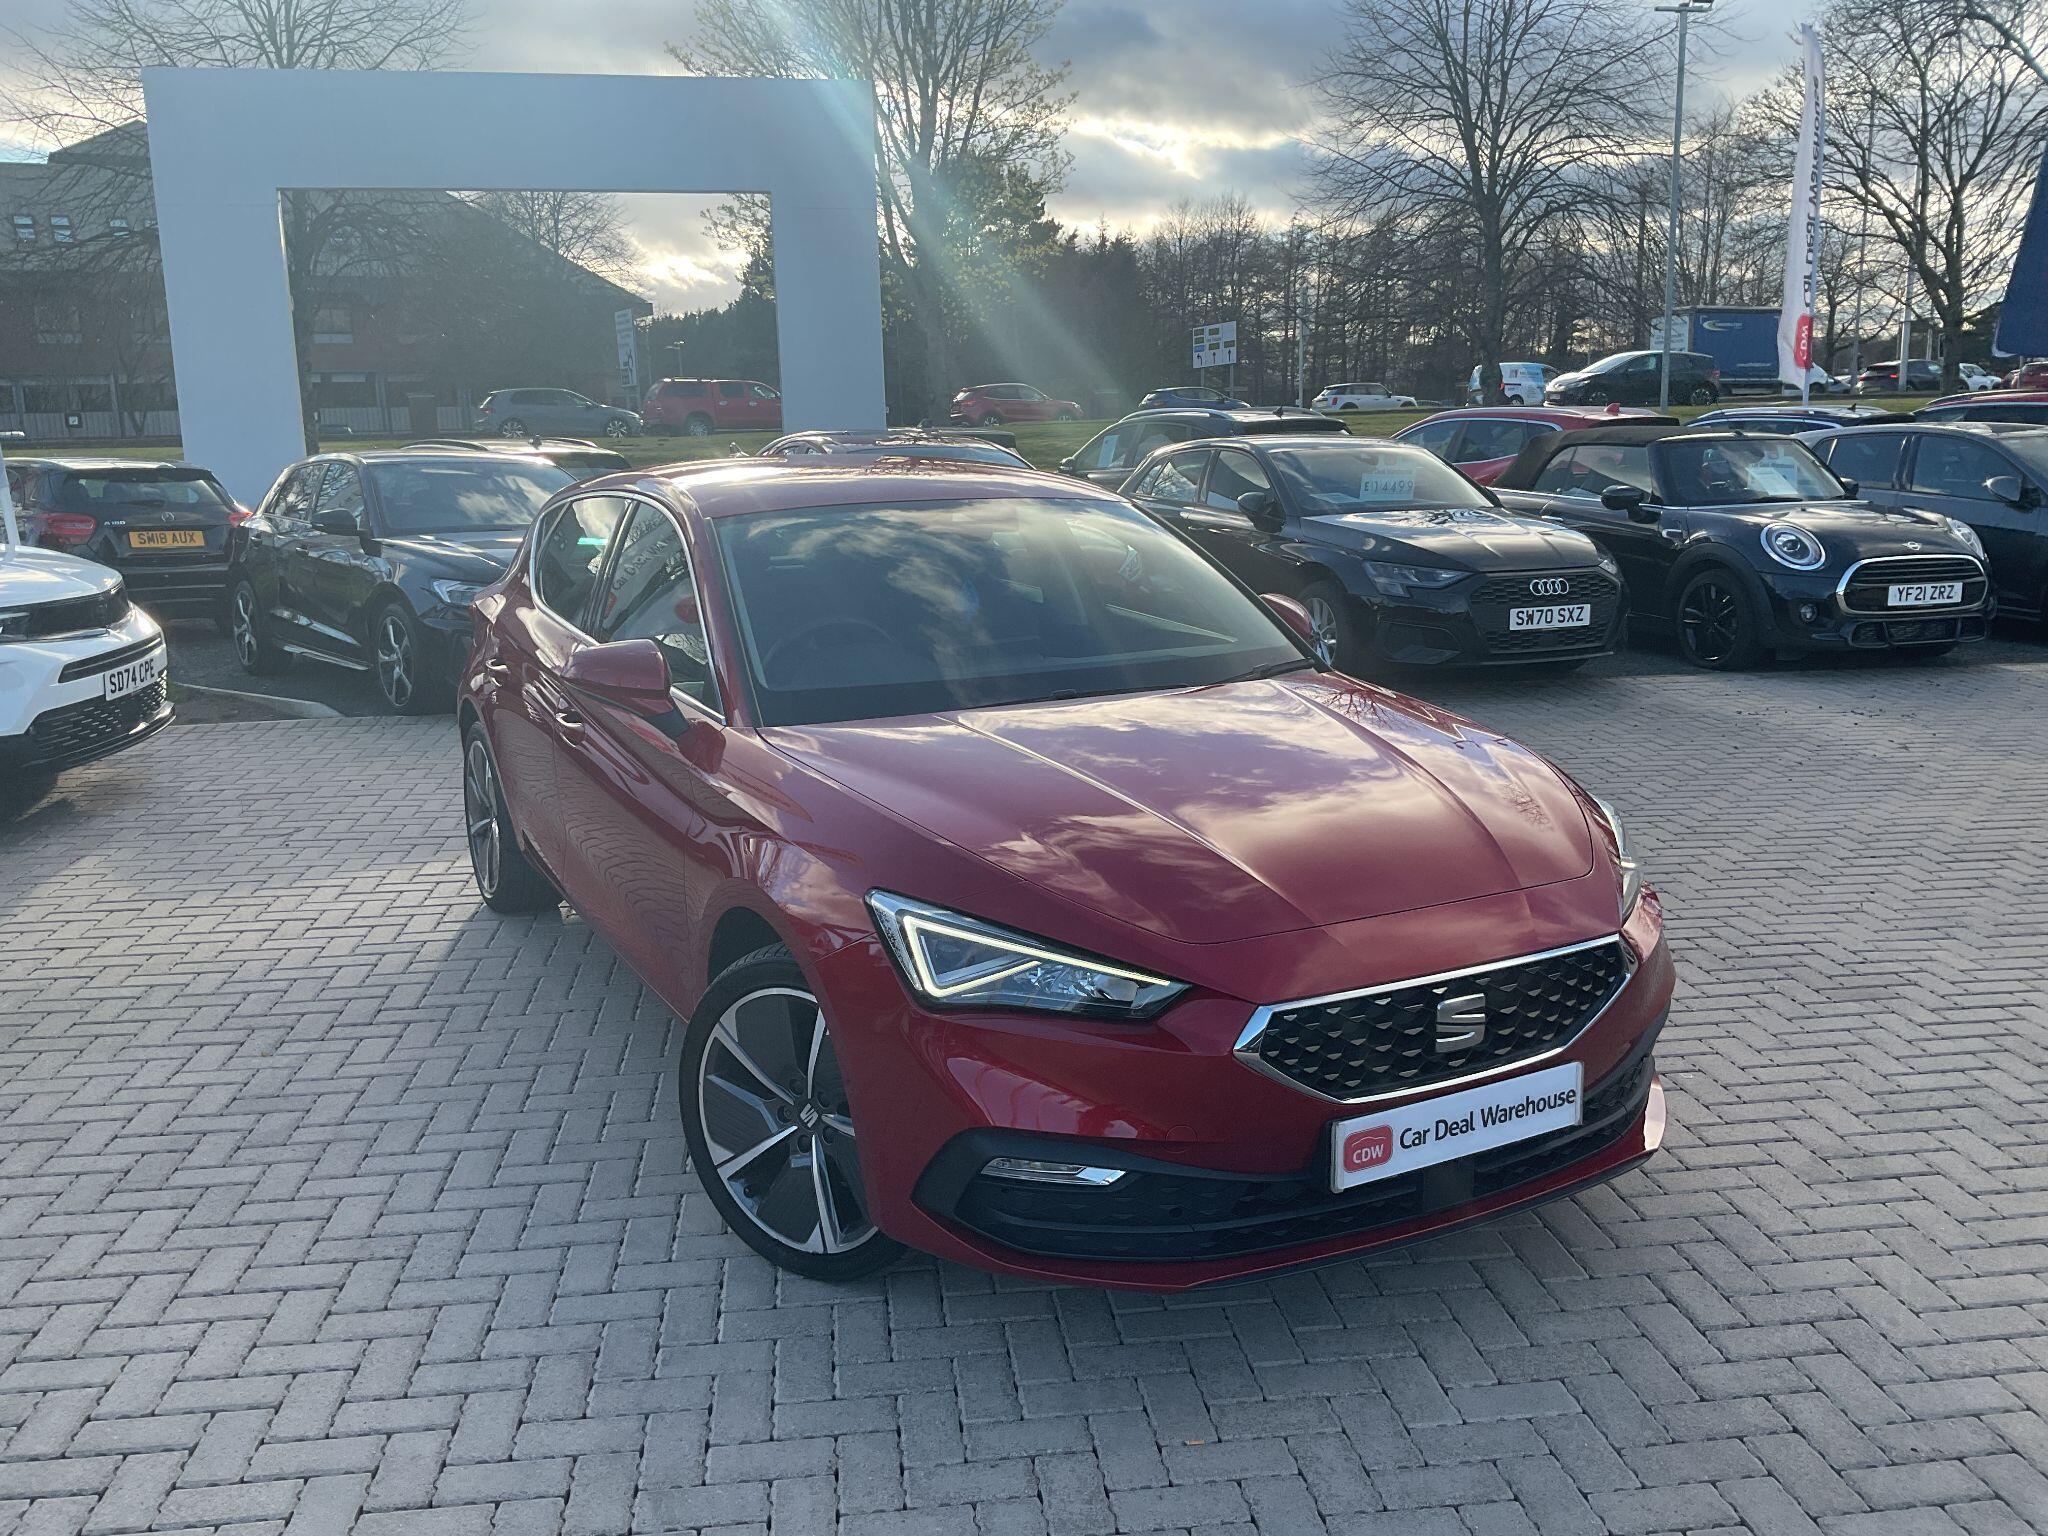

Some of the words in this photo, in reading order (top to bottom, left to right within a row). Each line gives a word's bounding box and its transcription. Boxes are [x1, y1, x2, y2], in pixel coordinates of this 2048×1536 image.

[172, 531, 196, 544] AUX
[1897, 586, 1927, 602] YF21
[1930, 585, 1955, 600] ZRZ
[1516, 608, 1554, 626] SW70
[1557, 606, 1585, 623] SXZ
[109, 666, 137, 694] SD74
[139, 658, 155, 683] CPE
[1399, 1127, 1431, 1149] Car
[1435, 1110, 1476, 1141] Deal
[1481, 1088, 1577, 1128] Warehouse
[1352, 1143, 1385, 1164] CDW
